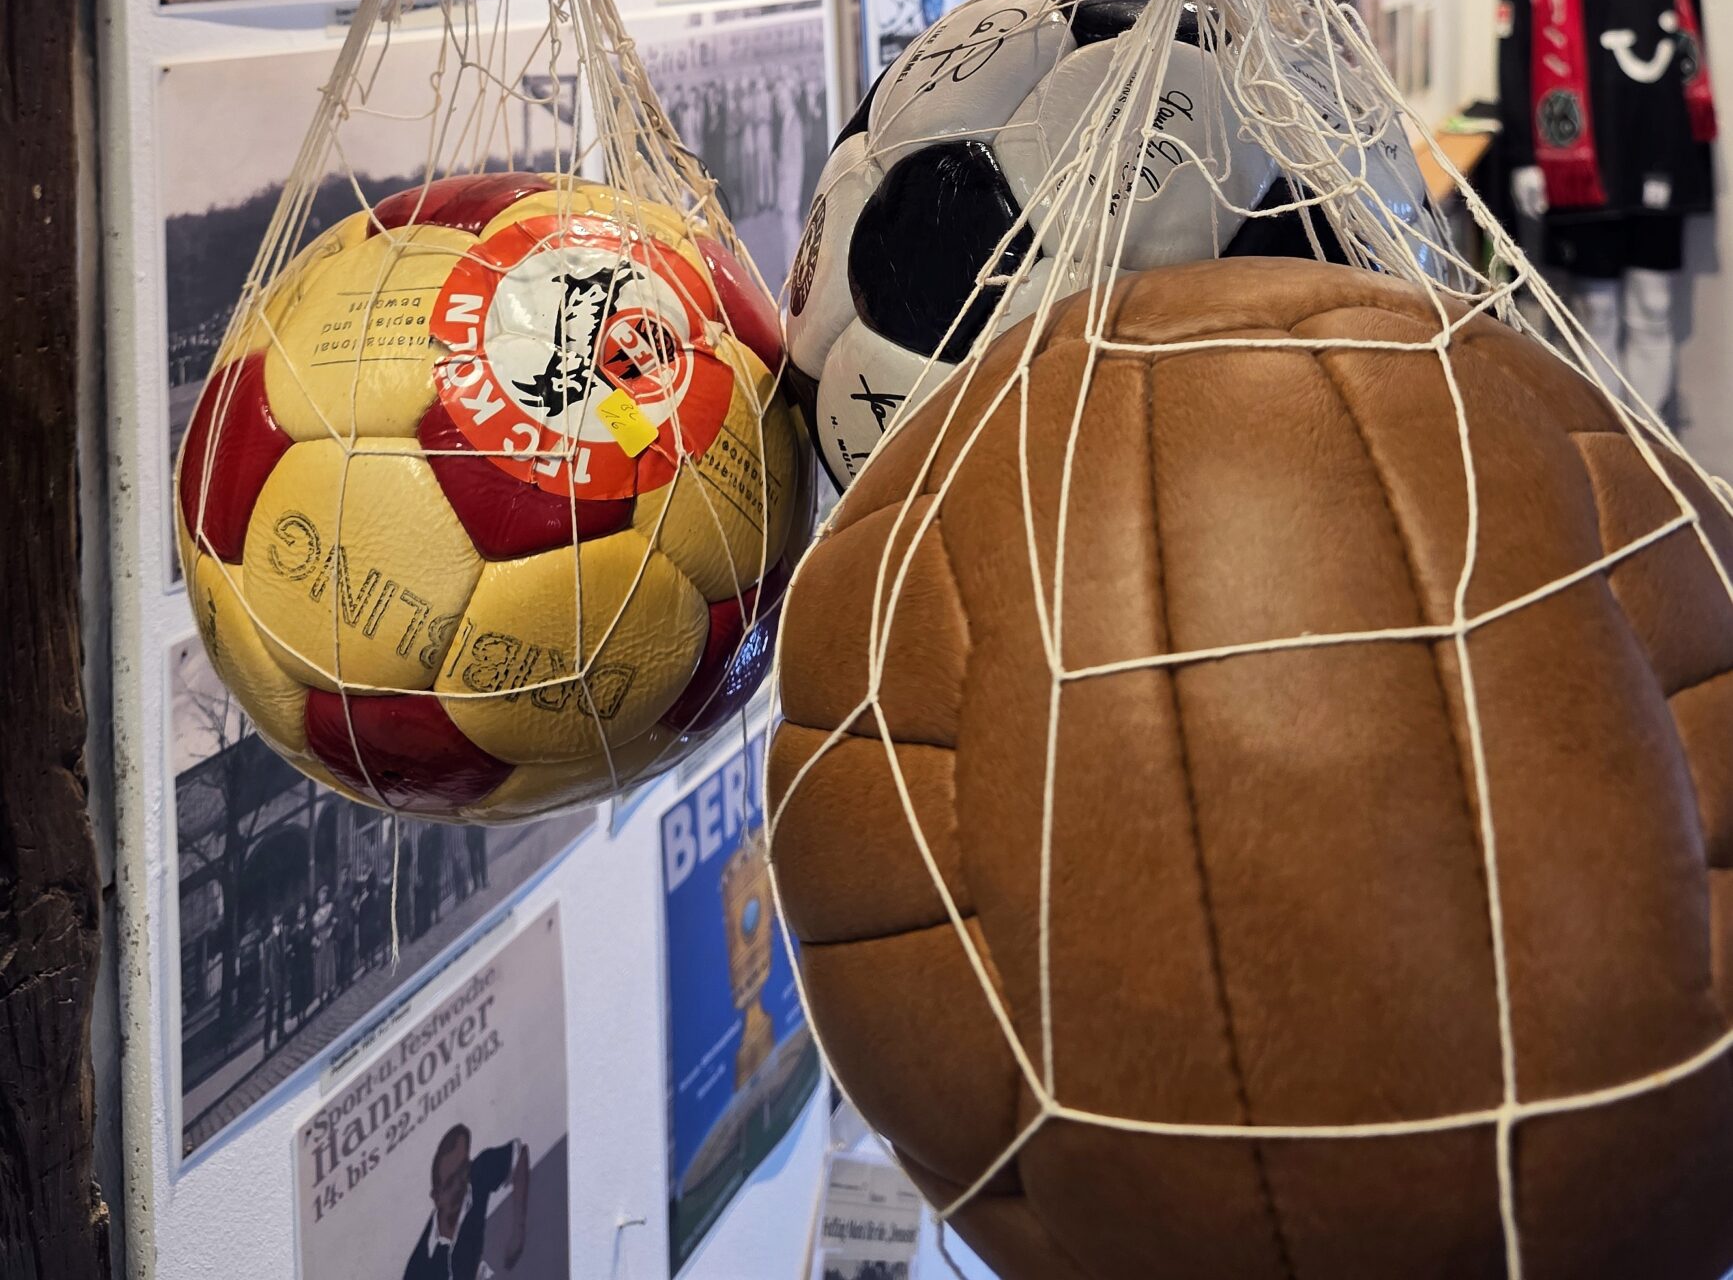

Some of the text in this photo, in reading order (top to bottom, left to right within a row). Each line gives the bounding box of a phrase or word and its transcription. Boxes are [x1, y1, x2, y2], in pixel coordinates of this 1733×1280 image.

[434, 293, 507, 426] KÖLN
[312, 994, 495, 1189] Hannover
[313, 1182, 345, 1224] 14.
[345, 1146, 381, 1192] bis
[384, 1110, 417, 1156] 22.
[416, 1063, 462, 1123] Juni
